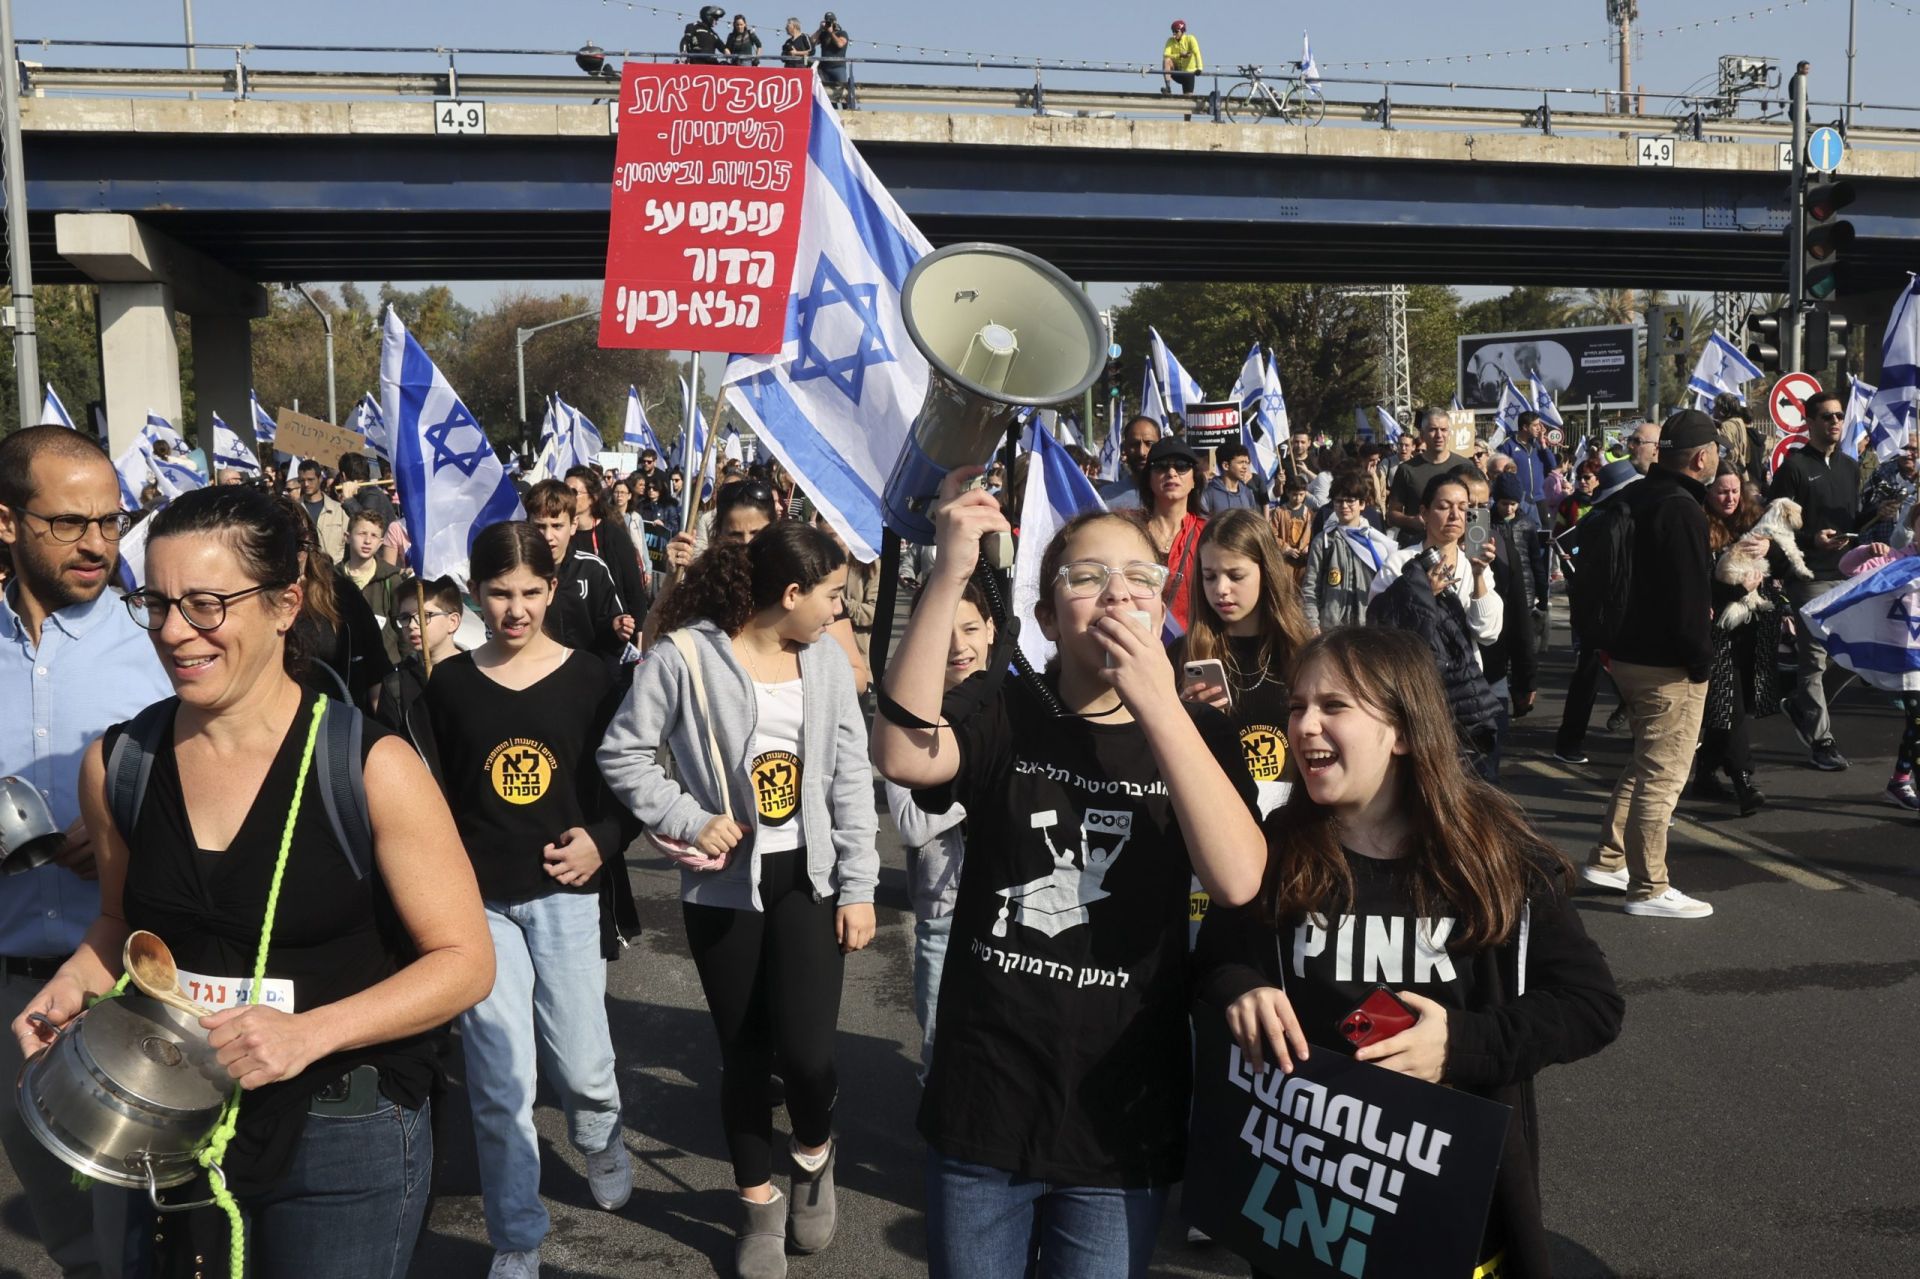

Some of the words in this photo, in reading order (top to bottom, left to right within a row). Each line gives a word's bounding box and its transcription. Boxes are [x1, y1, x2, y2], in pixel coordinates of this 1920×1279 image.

[628, 74, 690, 114] את
[441, 108, 479, 128] 4.9
[1642, 144, 1670, 161] 4.9
[708, 159, 793, 192] זכויות
[644, 199, 685, 235] על
[688, 199, 784, 237] נפלתם
[683, 247, 775, 289] הדור
[514, 738, 539, 748] גזענות
[1242, 734, 1276, 757] לא
[502, 749, 540, 773] לא
[502, 773, 540, 785] בבית
[756, 762, 792, 789] לא
[503, 785, 541, 796] ספרנו
[760, 784, 794, 802] בבית
[762, 795, 795, 813] ספרנו
[971, 937, 1074, 982] הדמוקרטיה
[1292, 911, 1458, 984] PINK
[1077, 966, 1130, 989] למען
[188, 980, 226, 1004] נגד
[1228, 1043, 1452, 1177] המשטרית
[1240, 1104, 1406, 1215] להפיכה
